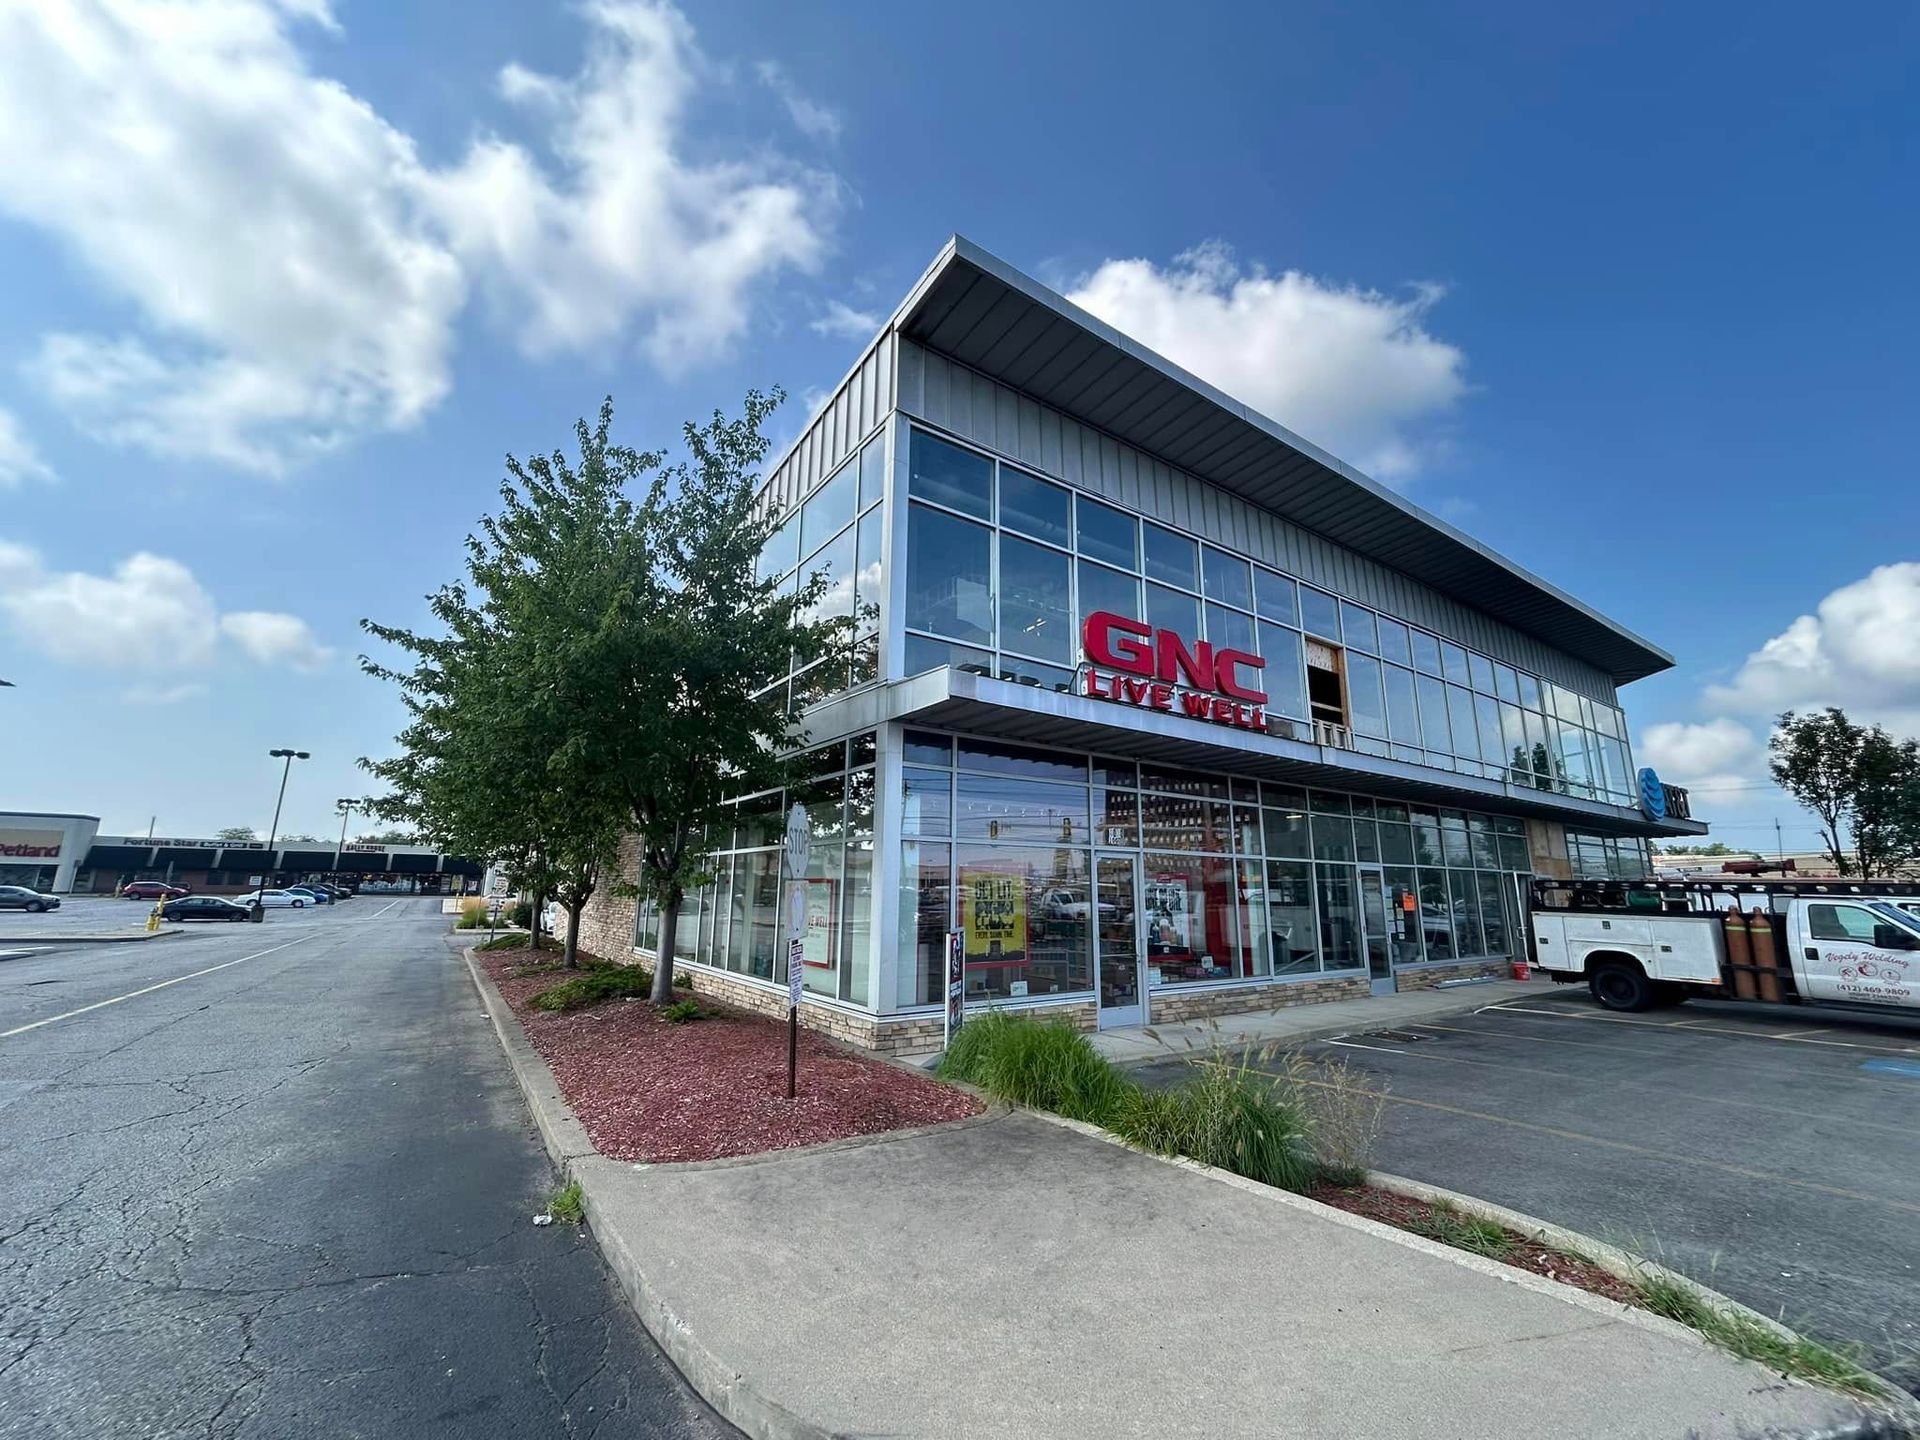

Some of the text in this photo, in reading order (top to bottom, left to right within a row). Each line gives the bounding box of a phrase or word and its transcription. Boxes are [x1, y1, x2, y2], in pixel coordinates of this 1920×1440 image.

[1083, 611, 1268, 704] GNC
[1087, 669, 1269, 732] LIVE WELL
[123, 838, 171, 847] Fortune
[173, 839, 198, 847] Star
[789, 827, 810, 854] STOP
[1861, 951, 1911, 968] Welding
[1836, 984, 1861, 992] (412)
